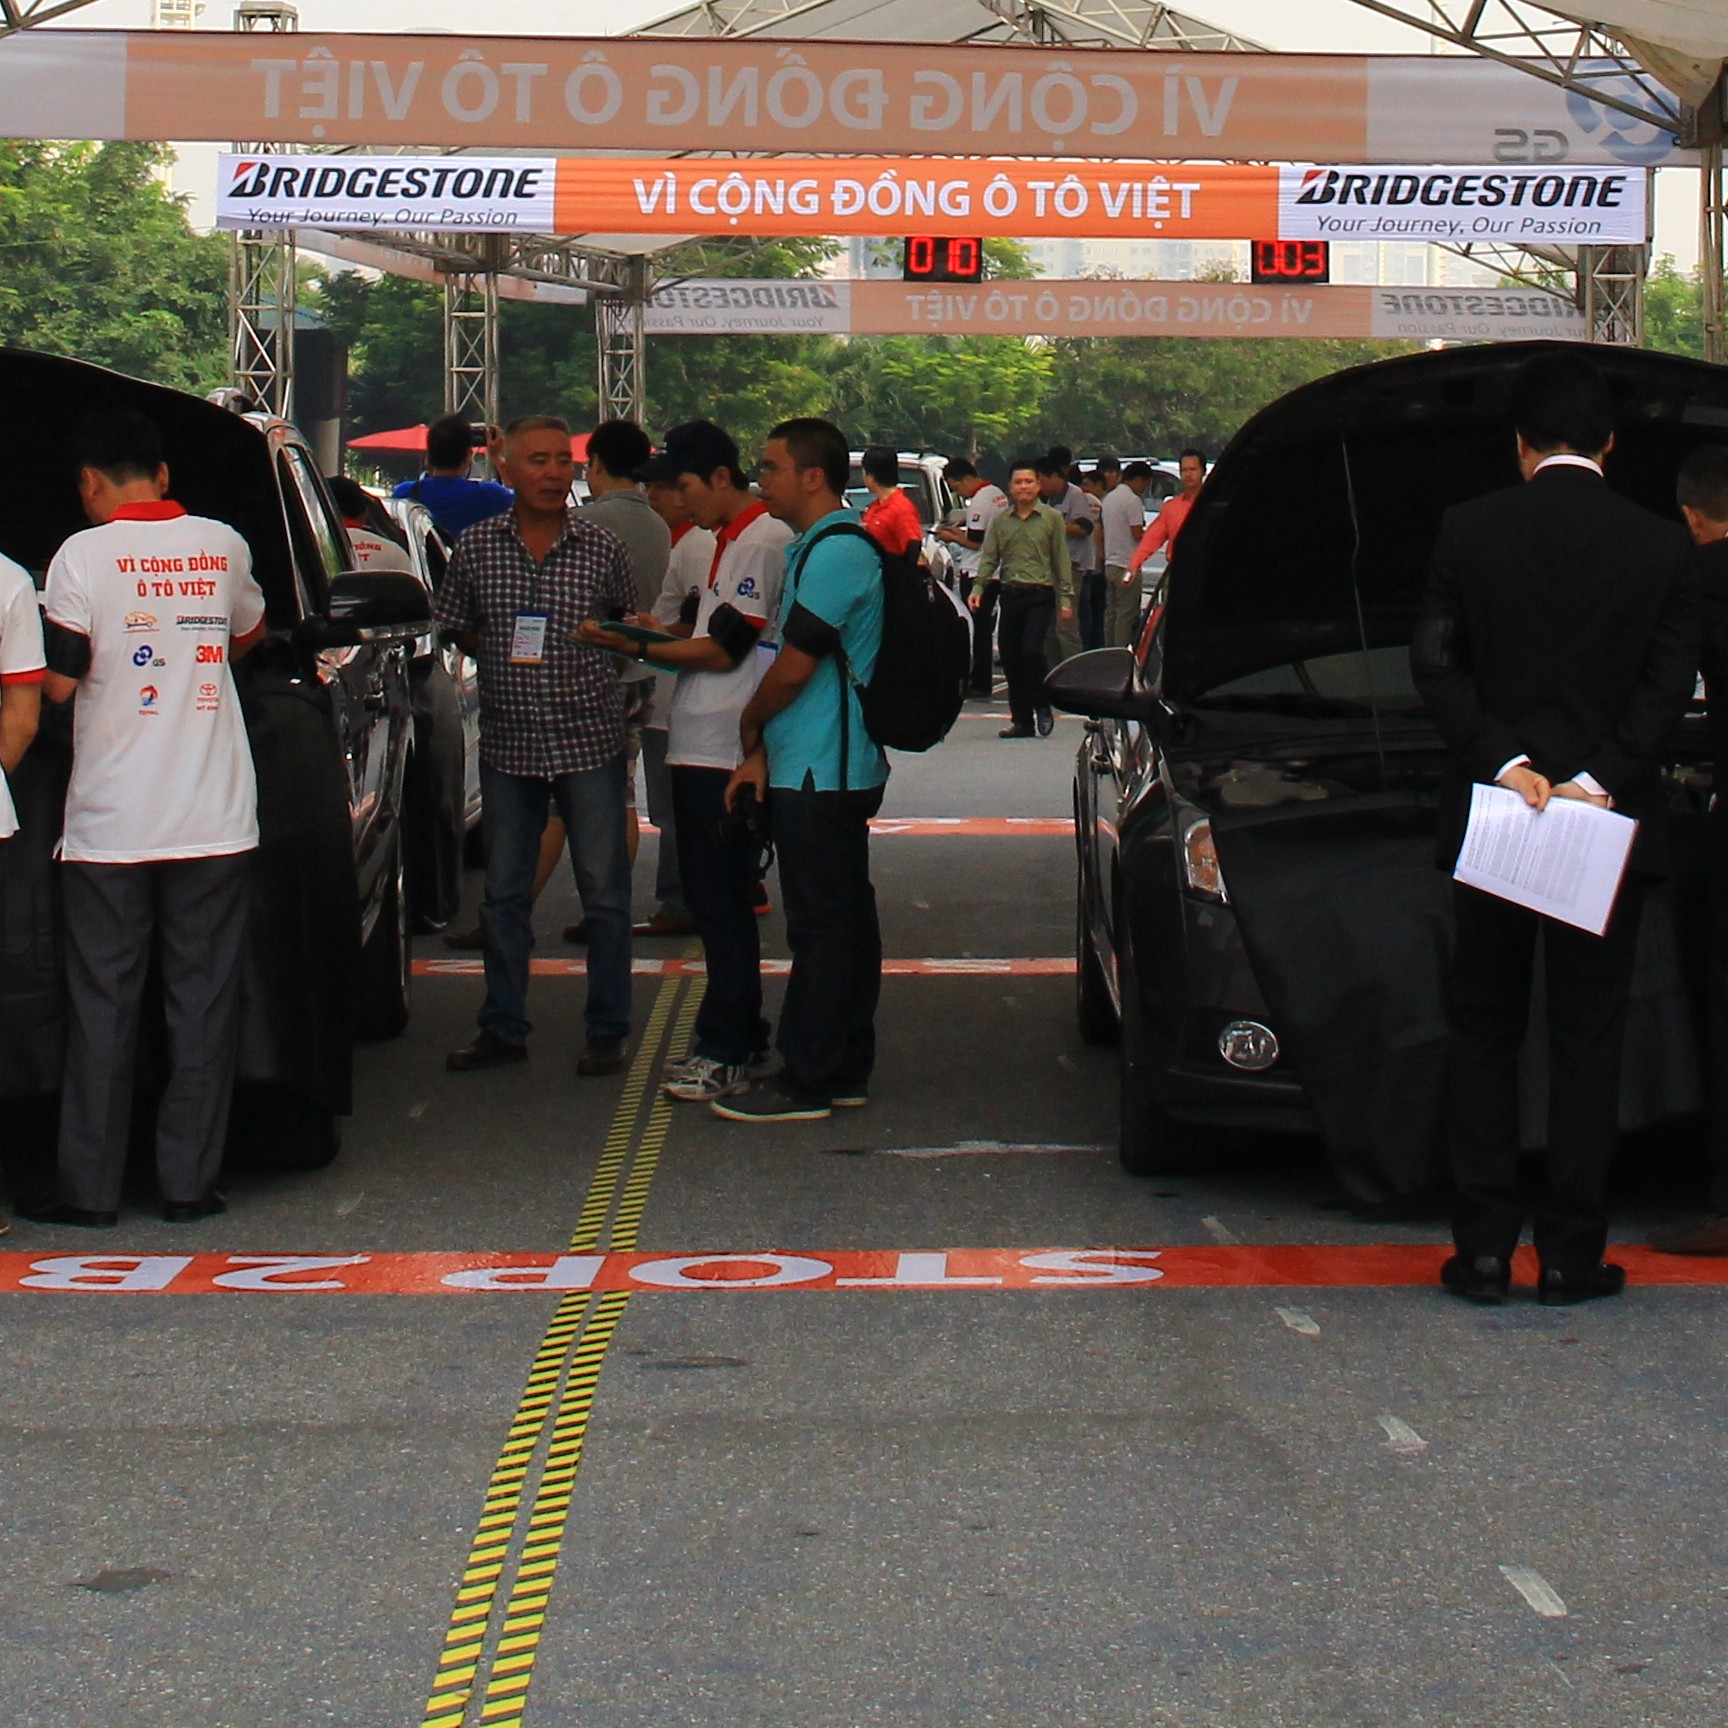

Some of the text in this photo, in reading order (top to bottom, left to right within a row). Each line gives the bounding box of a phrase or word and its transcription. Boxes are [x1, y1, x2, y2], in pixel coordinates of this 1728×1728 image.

[228, 161, 543, 198] BRIDGESTONE
[1296, 168, 1627, 208] BRIDGESTONE
[633, 168, 1201, 229] VÌ CỘNG ĐỒNG Ô TÔ VIỆT
[247, 207, 295, 224] Your
[394, 208, 435, 224] Our
[439, 208, 518, 225] Passion
[1317, 215, 1602, 237] Your Journey, Our Passion
[116, 548, 228, 577] VÌ CỘNG ĐỒNG
[137, 576, 216, 600] Ô TÔ VIỆT
[196, 645, 223, 664] 3M
[19, 1249, 1165, 1290] STOP 2B
